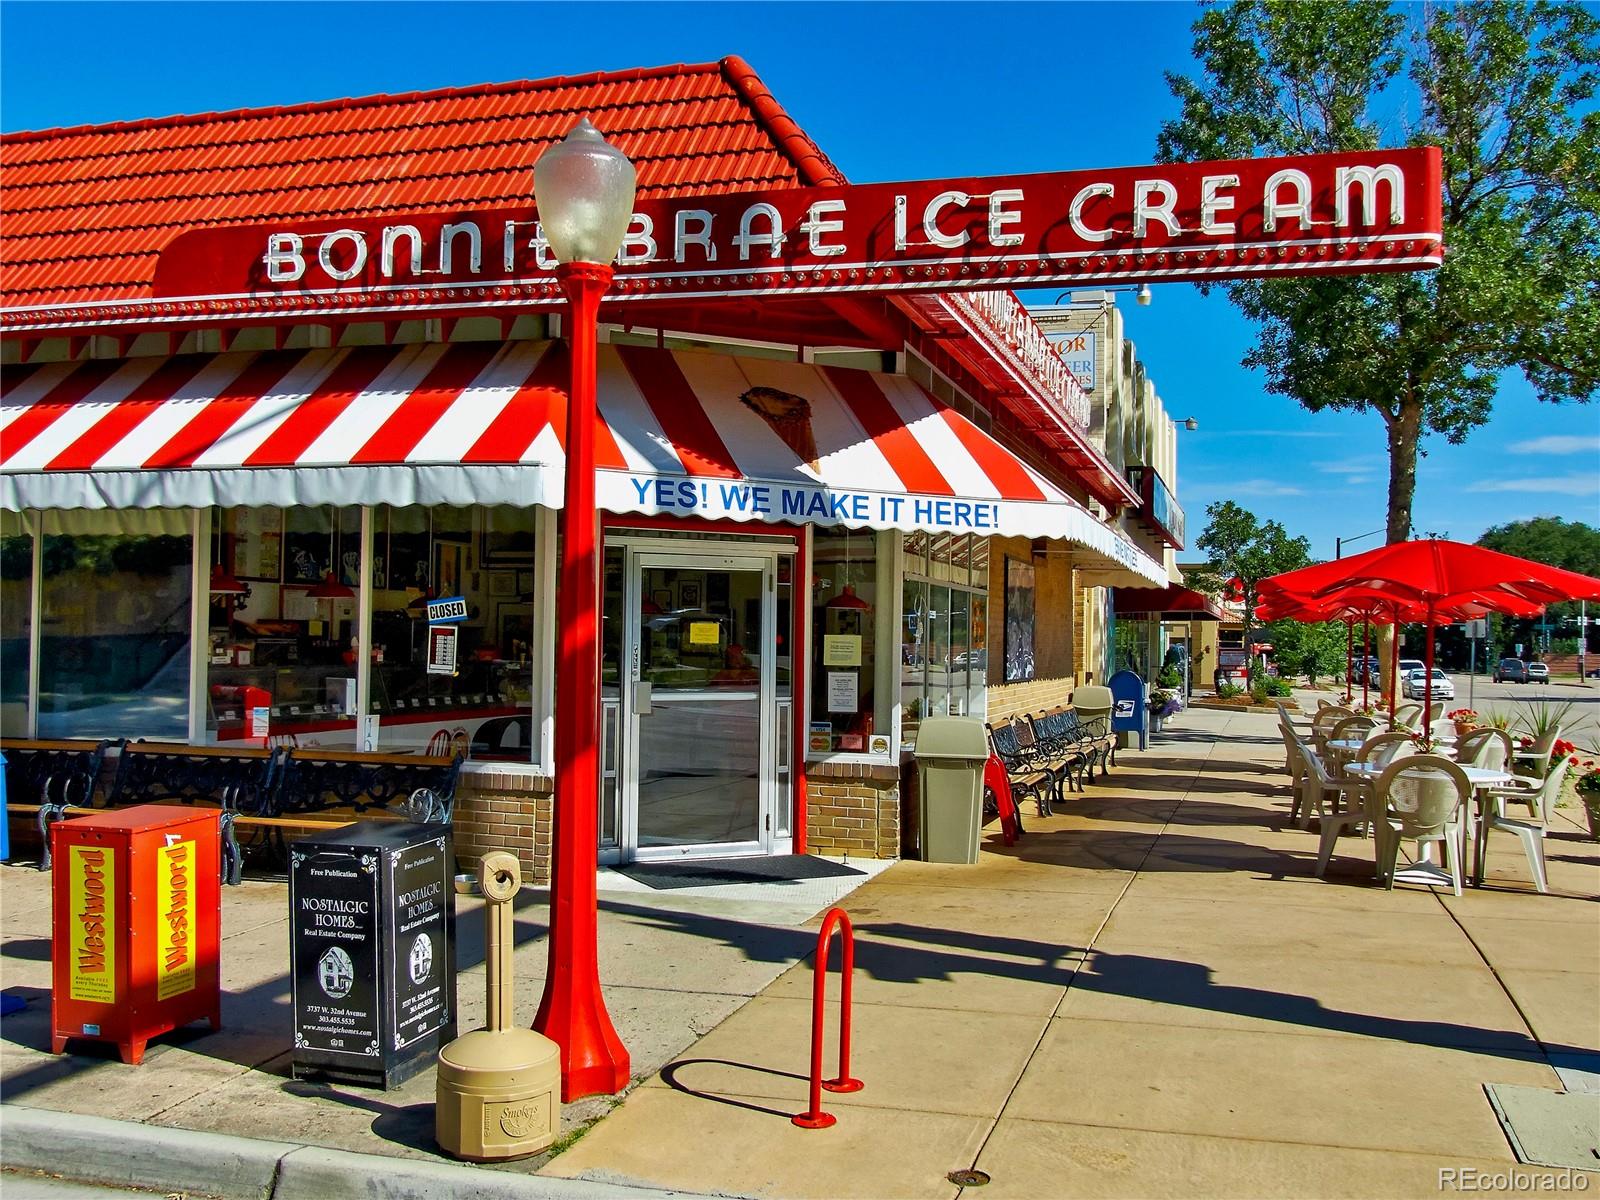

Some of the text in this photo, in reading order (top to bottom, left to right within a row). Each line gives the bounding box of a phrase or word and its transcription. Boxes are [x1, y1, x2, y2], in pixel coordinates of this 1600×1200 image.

[617, 200, 847, 263] BRAE
[895, 188, 1025, 251] ICE
[1069, 163, 1405, 242] CREAM
[631, 477, 1000, 529] YES! WE MAKE IT HERE!
[429, 602, 464, 620] CLOSED
[310, 868, 358, 878] Free Publication
[398, 881, 441, 907] NOSTALGIC
[77, 849, 106, 974] Westword
[164, 845, 189, 972] Westword
[302, 897, 369, 914] NOSTALGIC
[408, 899, 434, 919] HOMES
[315, 913, 355, 929] HOMES
[304, 928, 366, 941] Real Estate Company
[306, 1005, 367, 1018] 3737 W. 32nd Avenue
[318, 1015, 356, 1026] 303.455.5535
[302, 1024, 373, 1037] www.nostalgichomes.com
